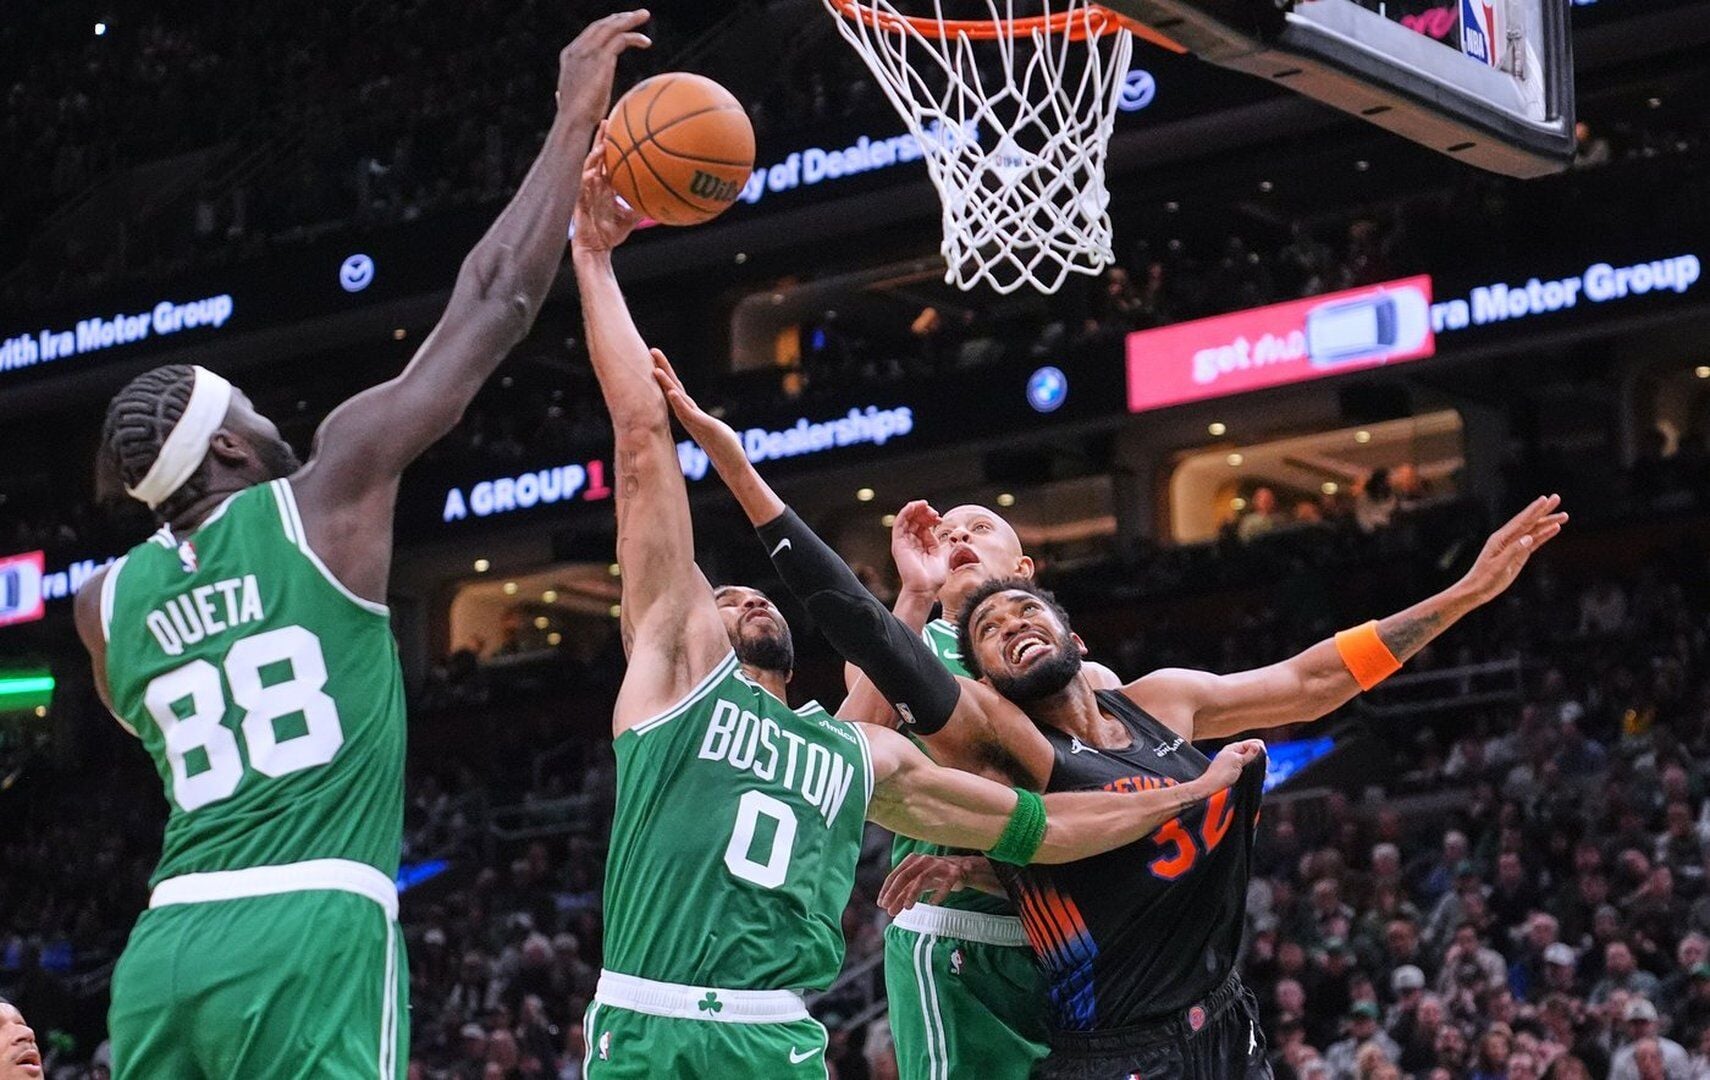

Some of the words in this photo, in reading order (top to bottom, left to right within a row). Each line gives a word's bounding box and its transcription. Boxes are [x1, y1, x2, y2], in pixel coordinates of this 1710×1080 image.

[1465, 27, 1485, 59] NBA
[690, 169, 738, 202] Wil
[767, 152, 799, 193] of
[1432, 299, 1469, 332] ra
[1471, 275, 1581, 323] Motor
[1583, 254, 1699, 300] Group
[39, 329, 75, 361] Ira
[75, 313, 150, 353] Motor
[152, 294, 234, 335] Group
[1193, 336, 1250, 384] get
[744, 405, 914, 463] Dealerships
[443, 487, 467, 522] A
[42, 572, 68, 600] ra
[146, 574, 264, 656] QUETA
[144, 625, 344, 813] 88
[698, 698, 855, 830] BOSTON
[723, 789, 799, 890] 0
